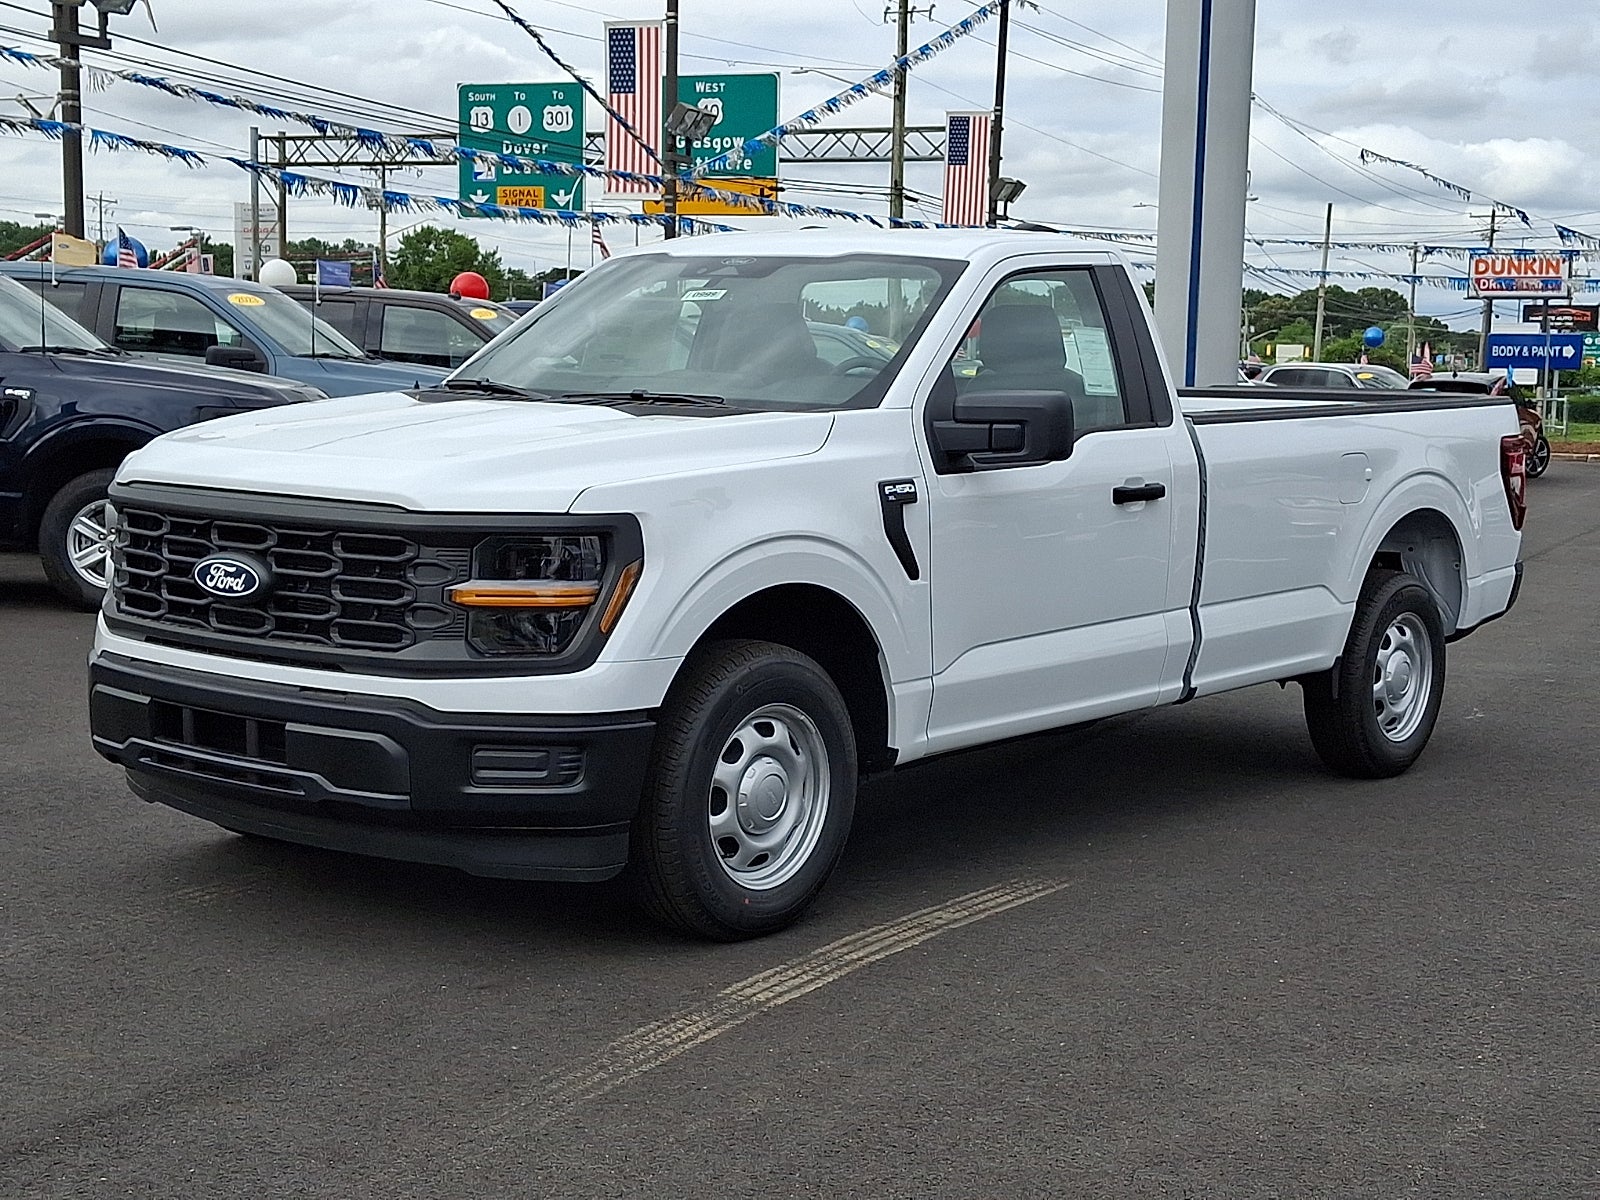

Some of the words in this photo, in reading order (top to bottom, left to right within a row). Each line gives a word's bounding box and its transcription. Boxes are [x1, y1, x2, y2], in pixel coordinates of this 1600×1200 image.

[695, 82, 726, 93] WEST
[468, 92, 496, 101] SOUTH
[475, 112, 489, 127] 13
[546, 111, 570, 126] 301
[502, 140, 549, 155] Dover
[675, 135, 745, 153] Gasgow
[502, 189, 539, 198] SIGNAL
[503, 199, 538, 208] AHEAD
[1492, 345, 1521, 357] BODY
[1521, 345, 1529, 357] &
[1531, 345, 1562, 357] PAINT
[206, 563, 247, 592] Ford
